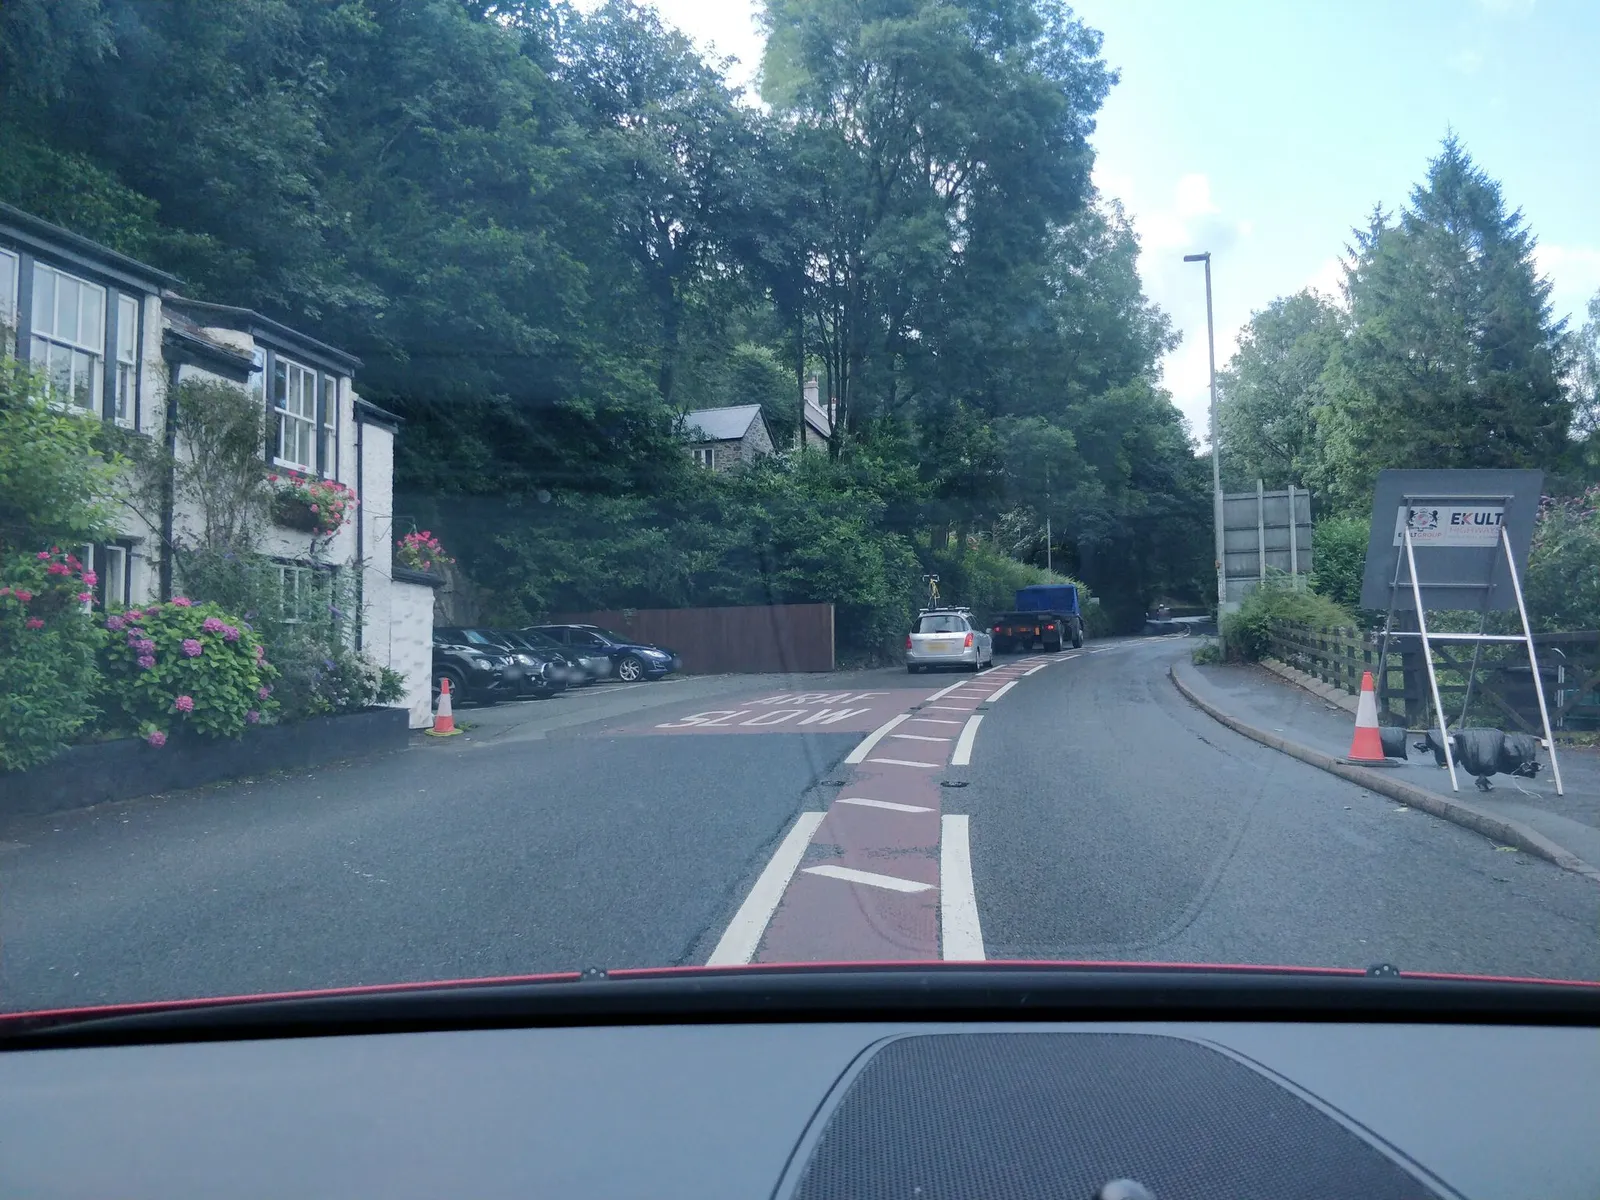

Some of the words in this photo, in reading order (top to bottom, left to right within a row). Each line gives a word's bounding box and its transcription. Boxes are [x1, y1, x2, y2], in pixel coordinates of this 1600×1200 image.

[1450, 512, 1504, 525] EKULT
[741, 692, 890, 706] ARAF
[654, 708, 872, 728] SLOW
